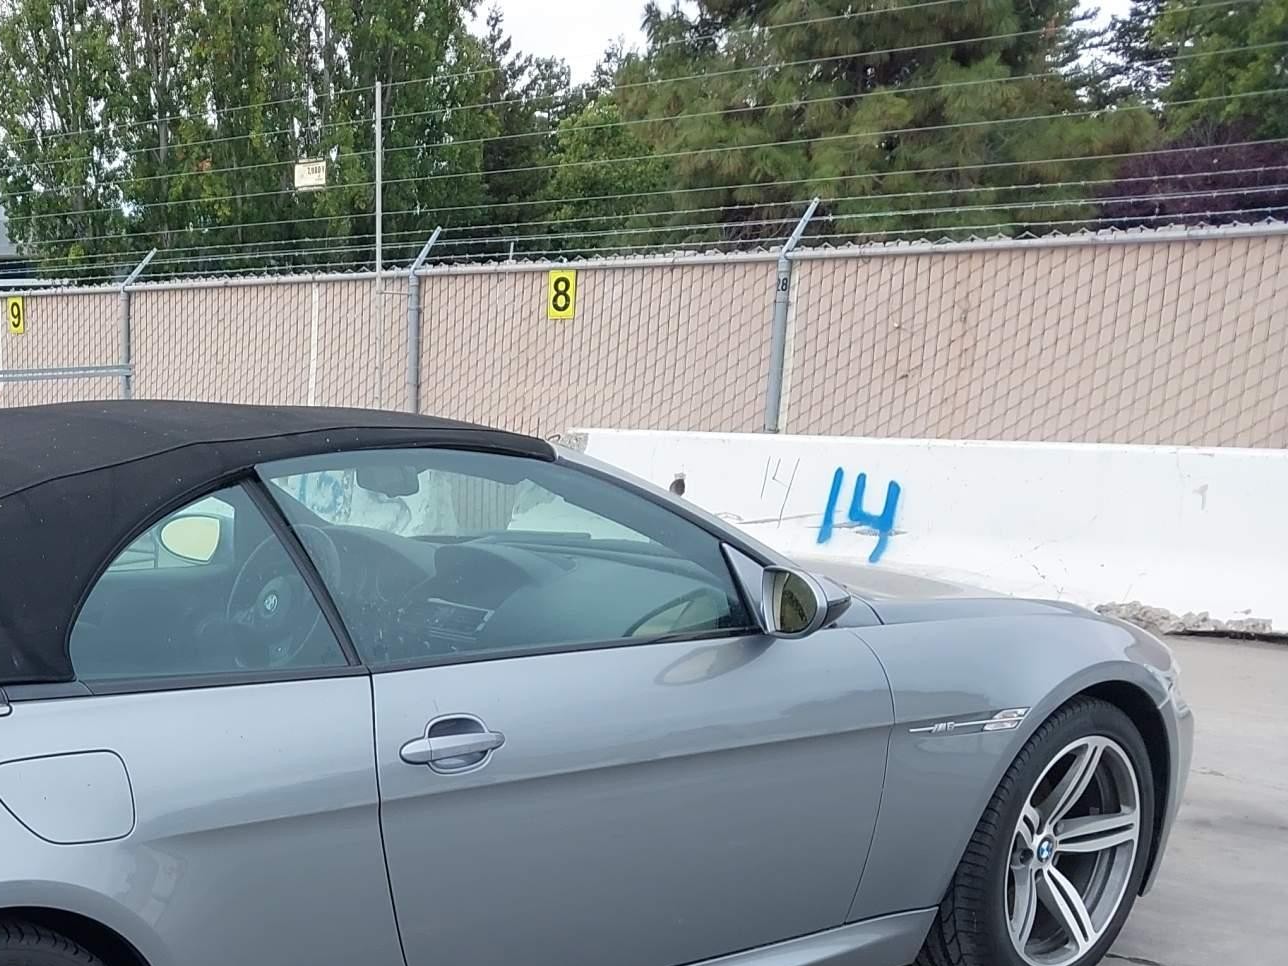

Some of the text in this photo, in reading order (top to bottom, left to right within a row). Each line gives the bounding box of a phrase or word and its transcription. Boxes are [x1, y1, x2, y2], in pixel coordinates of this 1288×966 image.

[552, 276, 571, 312] 8
[11, 302, 21, 328] 9
[816, 466, 902, 564] 14
